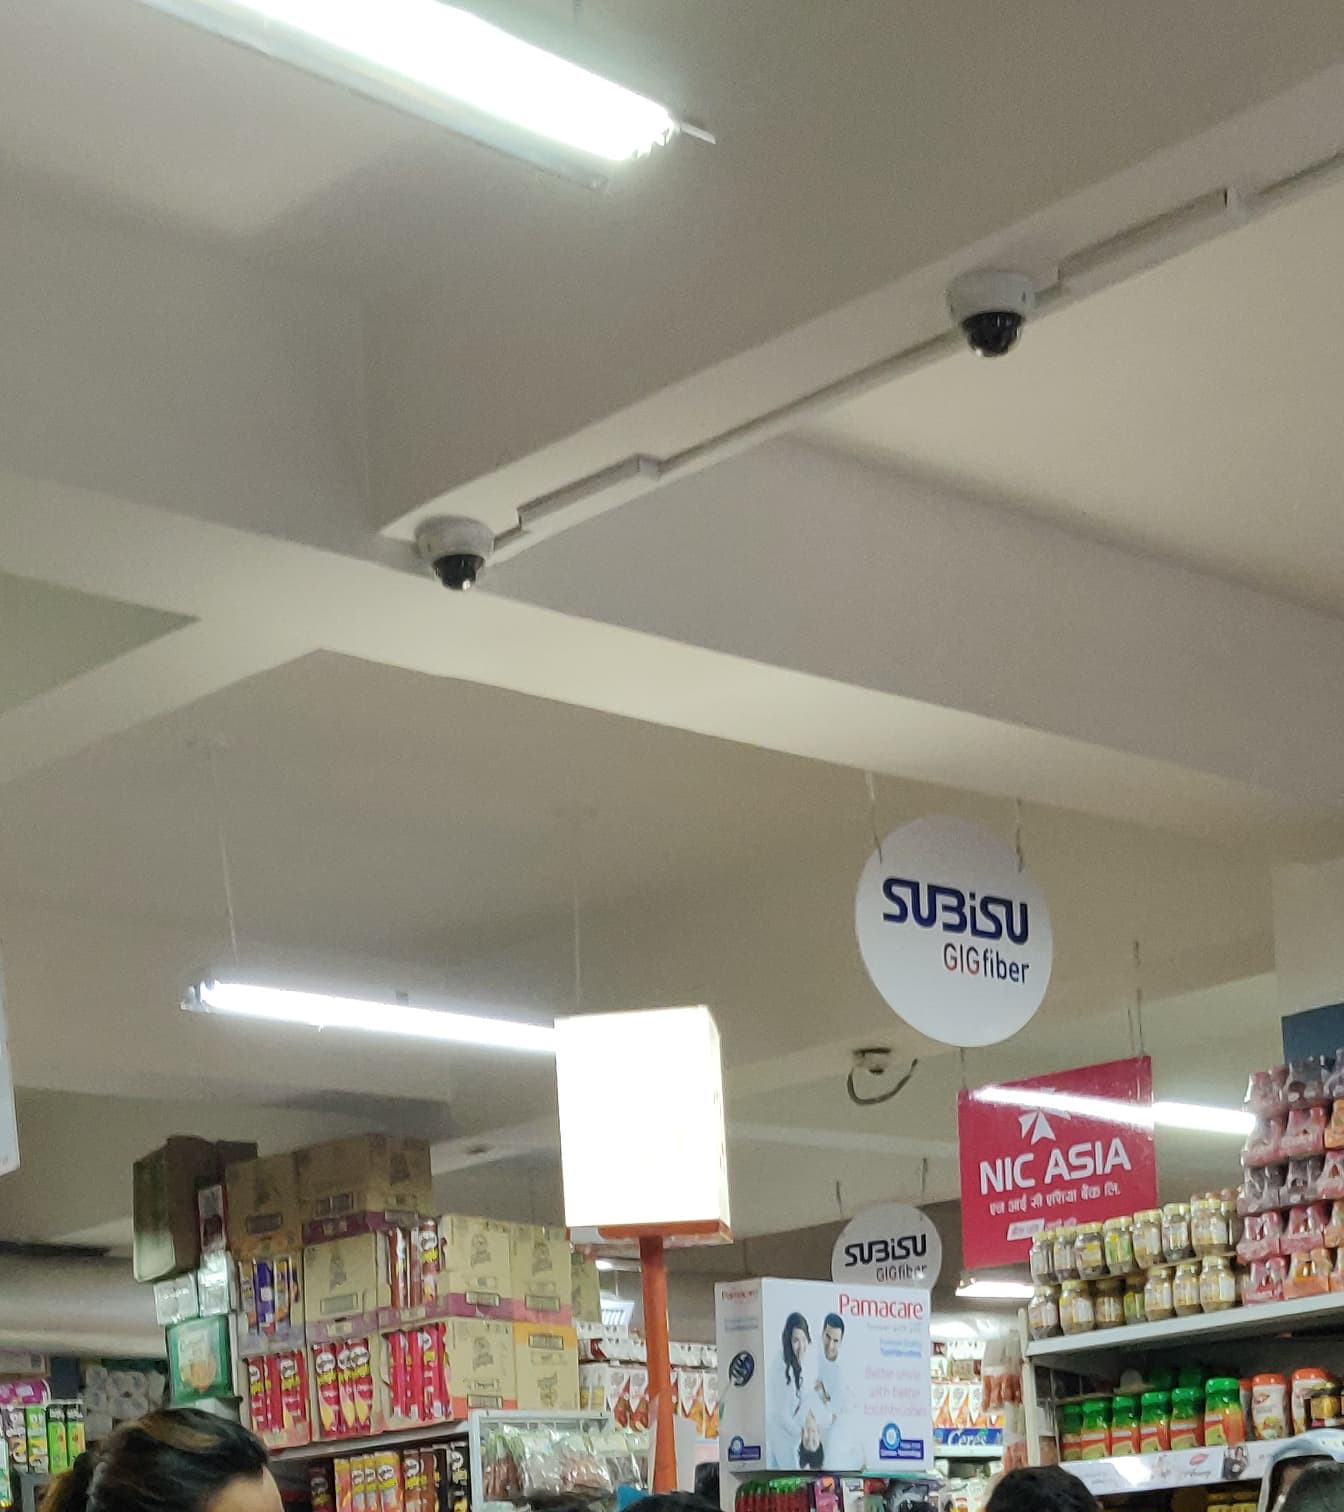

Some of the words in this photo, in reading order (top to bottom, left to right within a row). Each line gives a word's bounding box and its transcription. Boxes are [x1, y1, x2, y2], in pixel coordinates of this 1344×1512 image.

[944, 942, 1030, 984] GIGfiber
[979, 1153, 1036, 1195] NIC
[1044, 1137, 1132, 1185] ASIA
[838, 1293, 924, 1320] Pamacare
